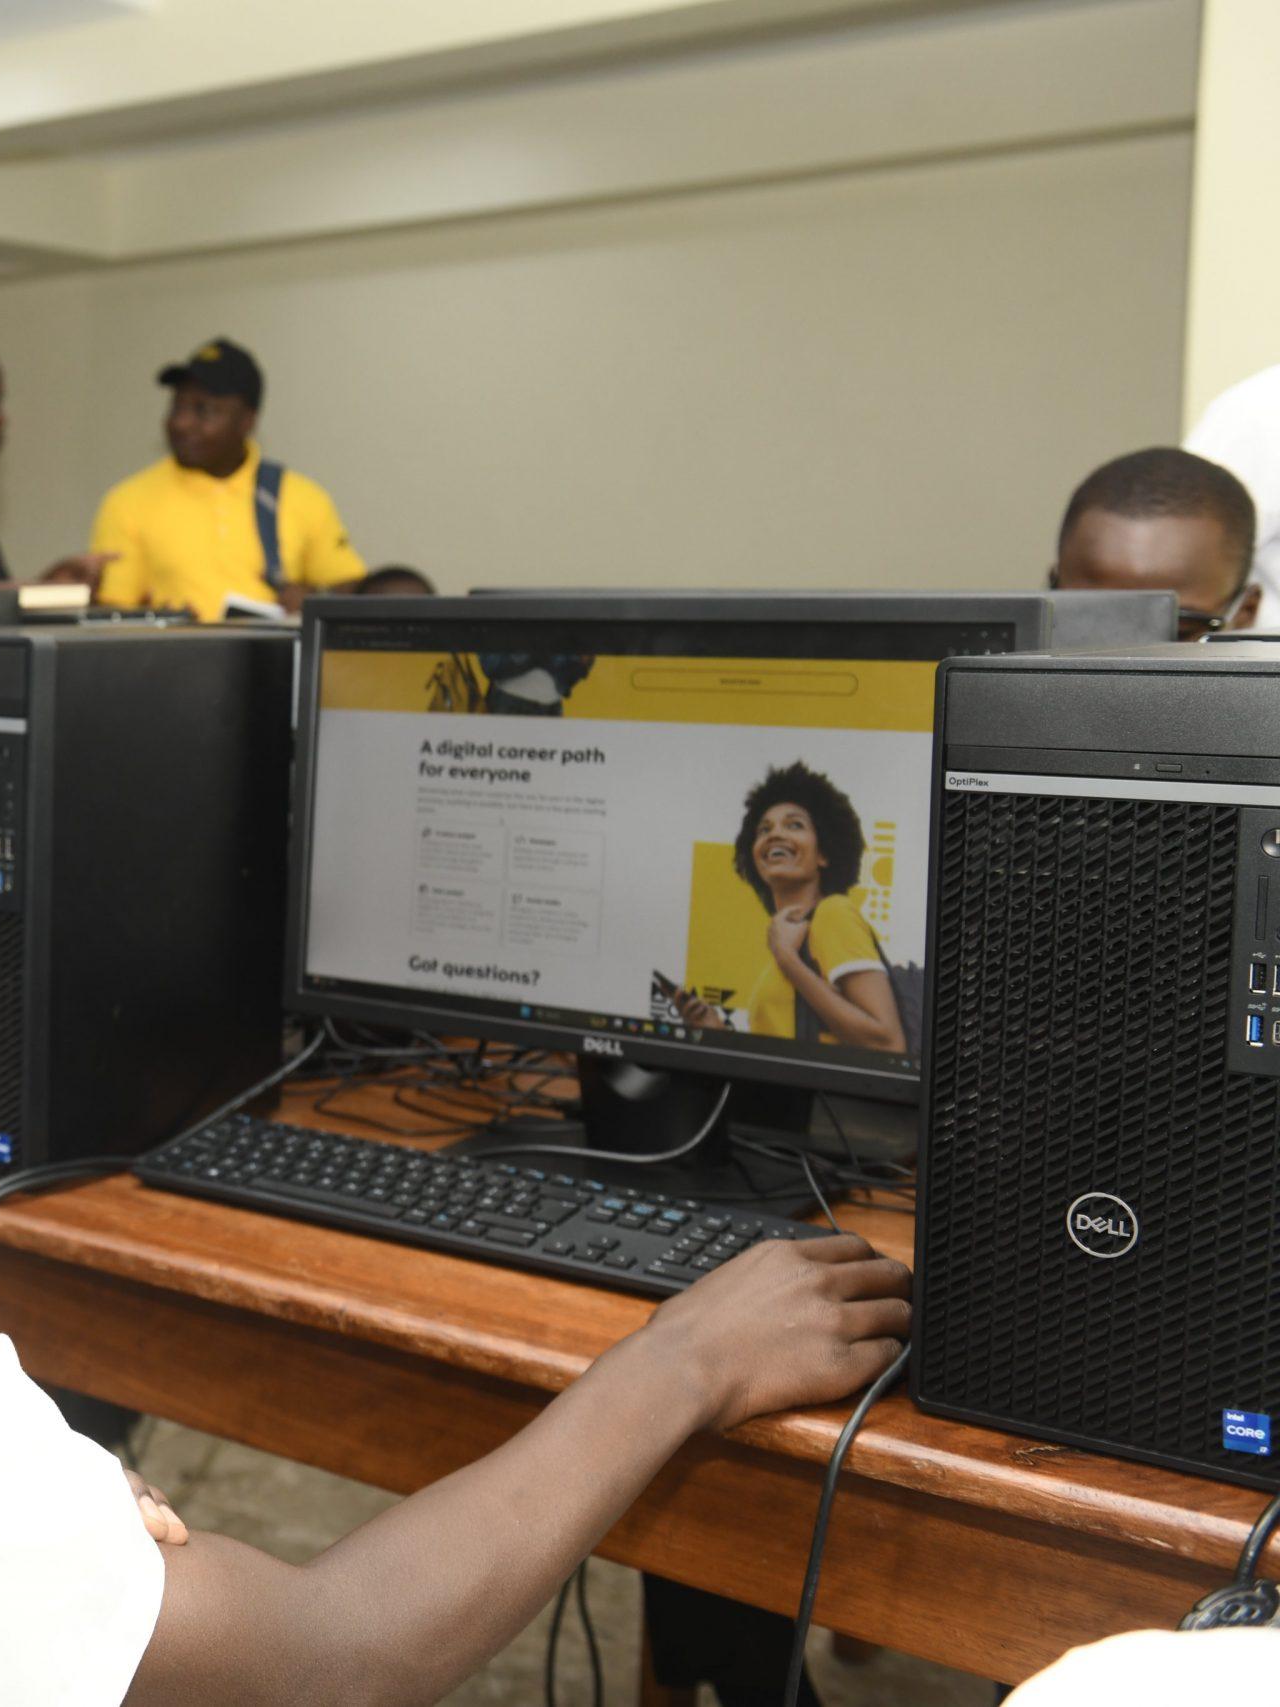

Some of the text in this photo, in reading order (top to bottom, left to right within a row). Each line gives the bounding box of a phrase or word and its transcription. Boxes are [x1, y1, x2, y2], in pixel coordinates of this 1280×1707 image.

[420, 739, 606, 766] A digital career path
[419, 761, 532, 785] for everyone
[949, 776, 990, 788] OptiPlex
[408, 954, 541, 987] Got questions?
[583, 1036, 624, 1057] DELL
[1076, 1213, 1131, 1238] DELL
